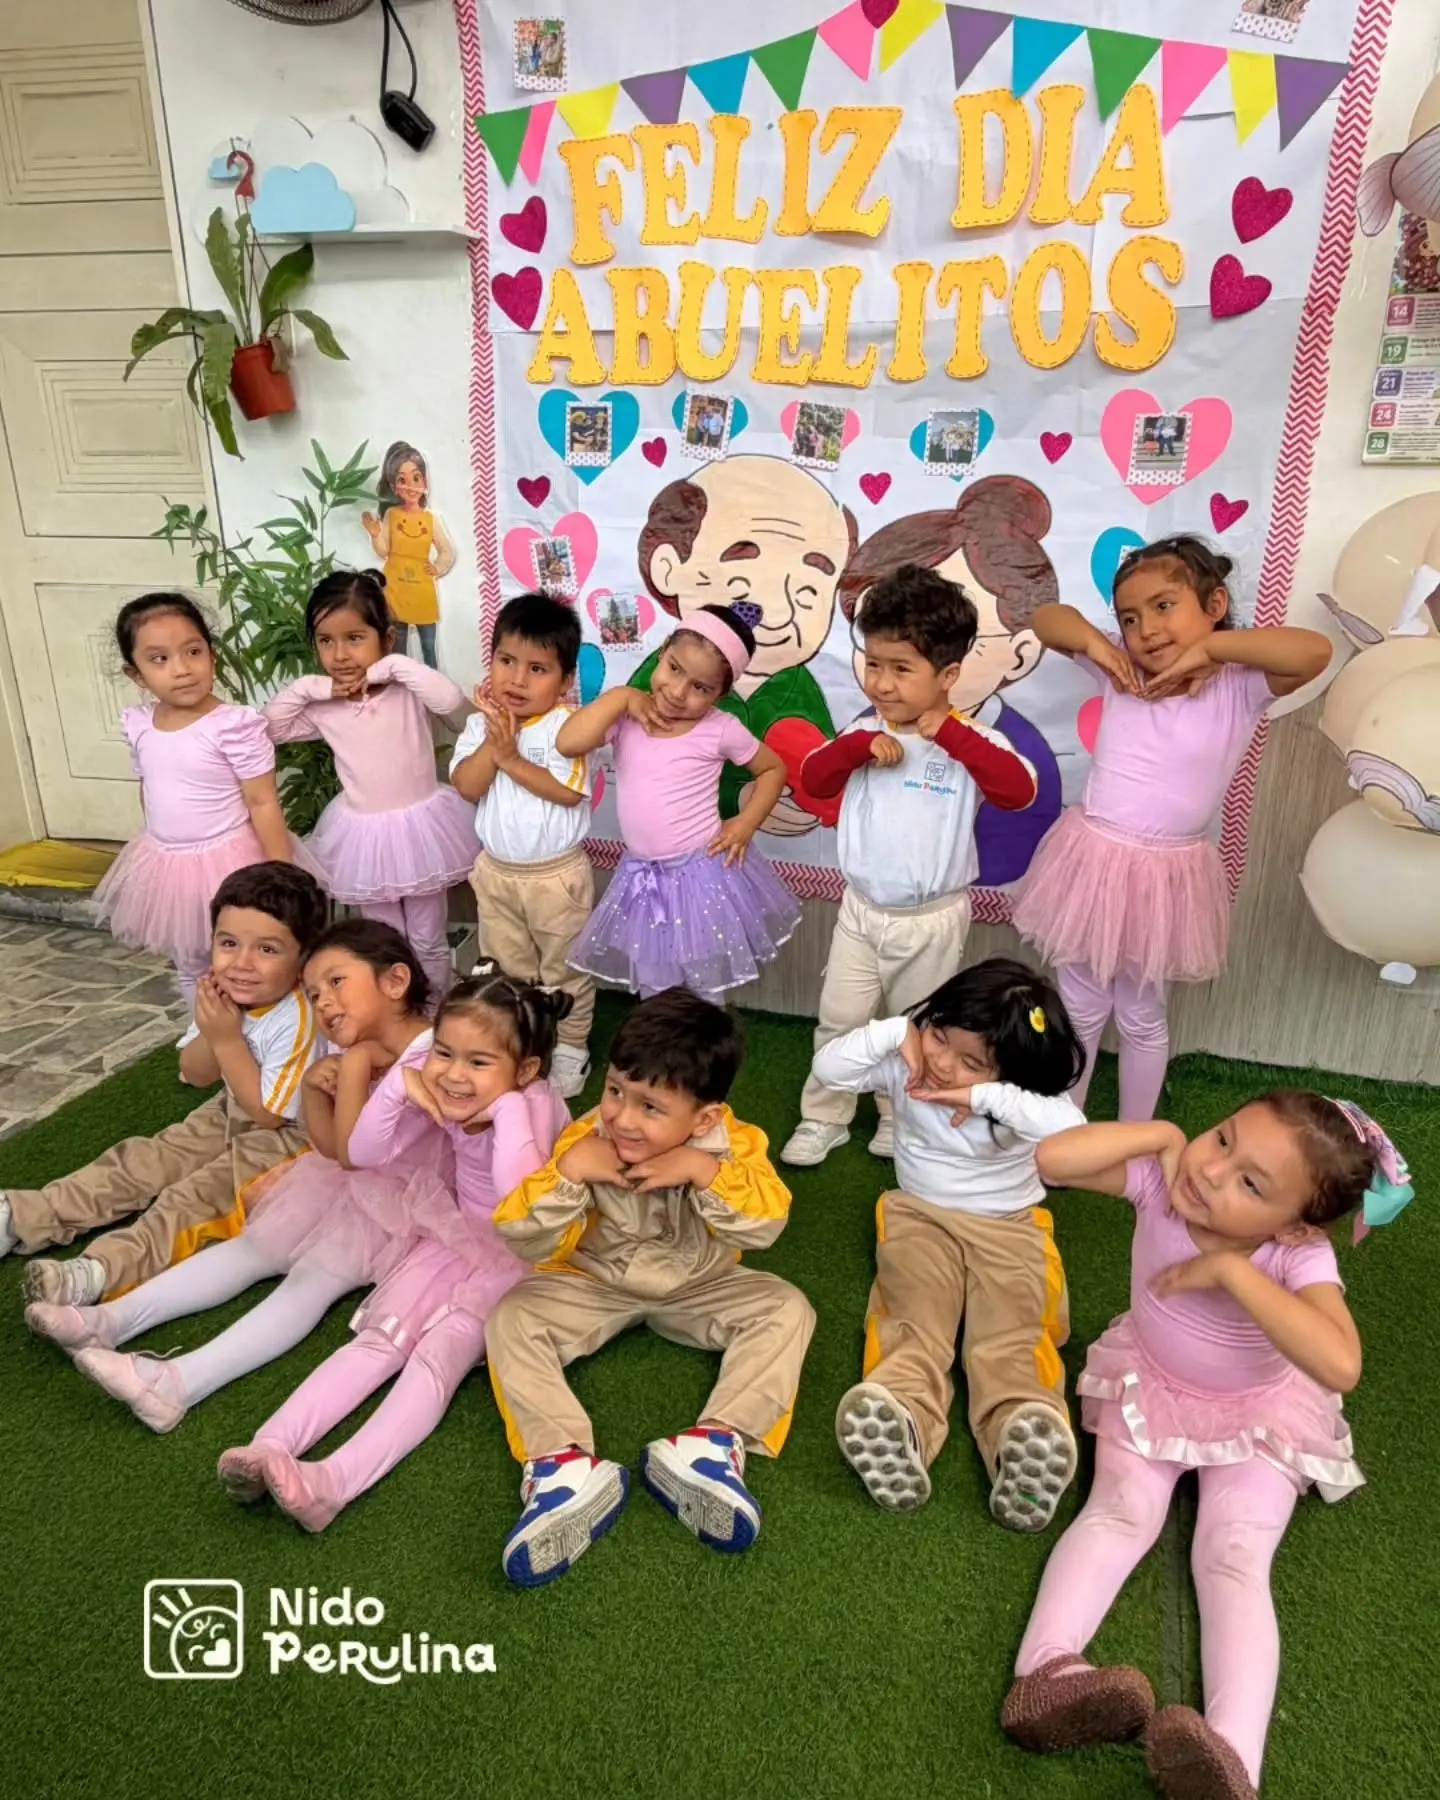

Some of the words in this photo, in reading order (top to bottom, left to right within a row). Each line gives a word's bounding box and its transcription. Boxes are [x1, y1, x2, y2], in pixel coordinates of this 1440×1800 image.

[559, 105, 904, 266] FELIZ
[951, 83, 1170, 230] DIA
[526, 234, 1184, 389] ABUELITOS
[1393, 304, 1409, 318] 14
[1387, 345, 1402, 357] 19
[1381, 377, 1396, 390] 21
[1375, 409, 1392, 421] 24
[1370, 438, 1385, 449] 28
